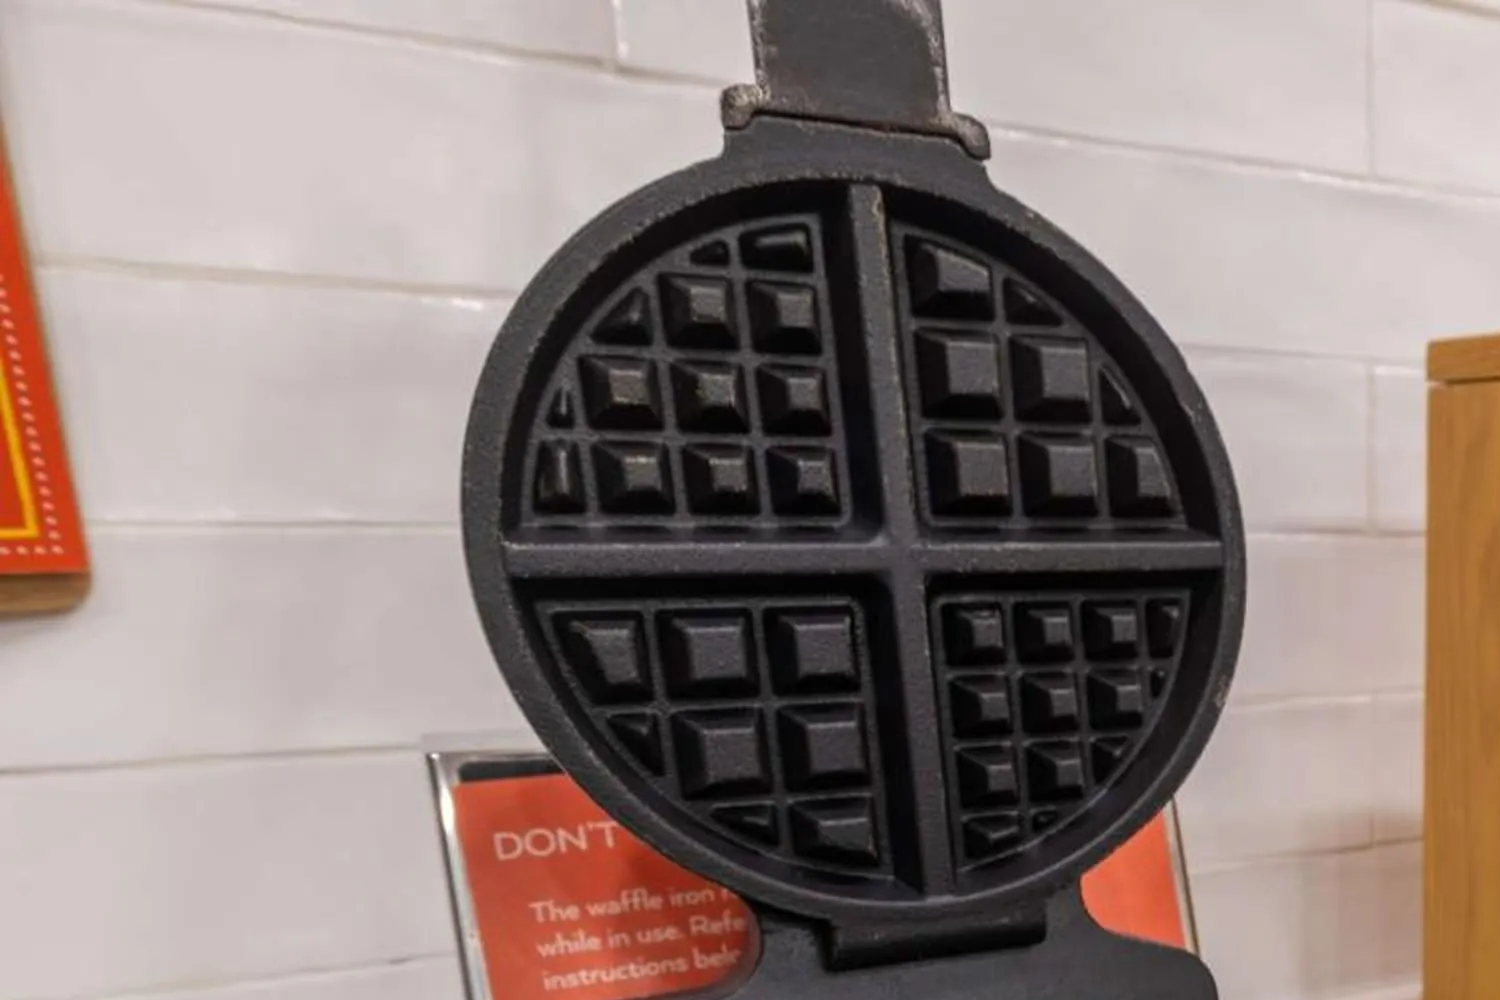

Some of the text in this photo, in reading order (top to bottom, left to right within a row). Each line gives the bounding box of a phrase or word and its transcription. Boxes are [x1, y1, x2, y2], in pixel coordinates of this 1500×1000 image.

[493, 820, 618, 860] DON'T
[529, 901, 580, 923] The
[586, 887, 662, 917] waffle
[670, 885, 716, 906] iron
[537, 928, 601, 957] while
[608, 928, 630, 947] in
[543, 950, 688, 990] instructions
